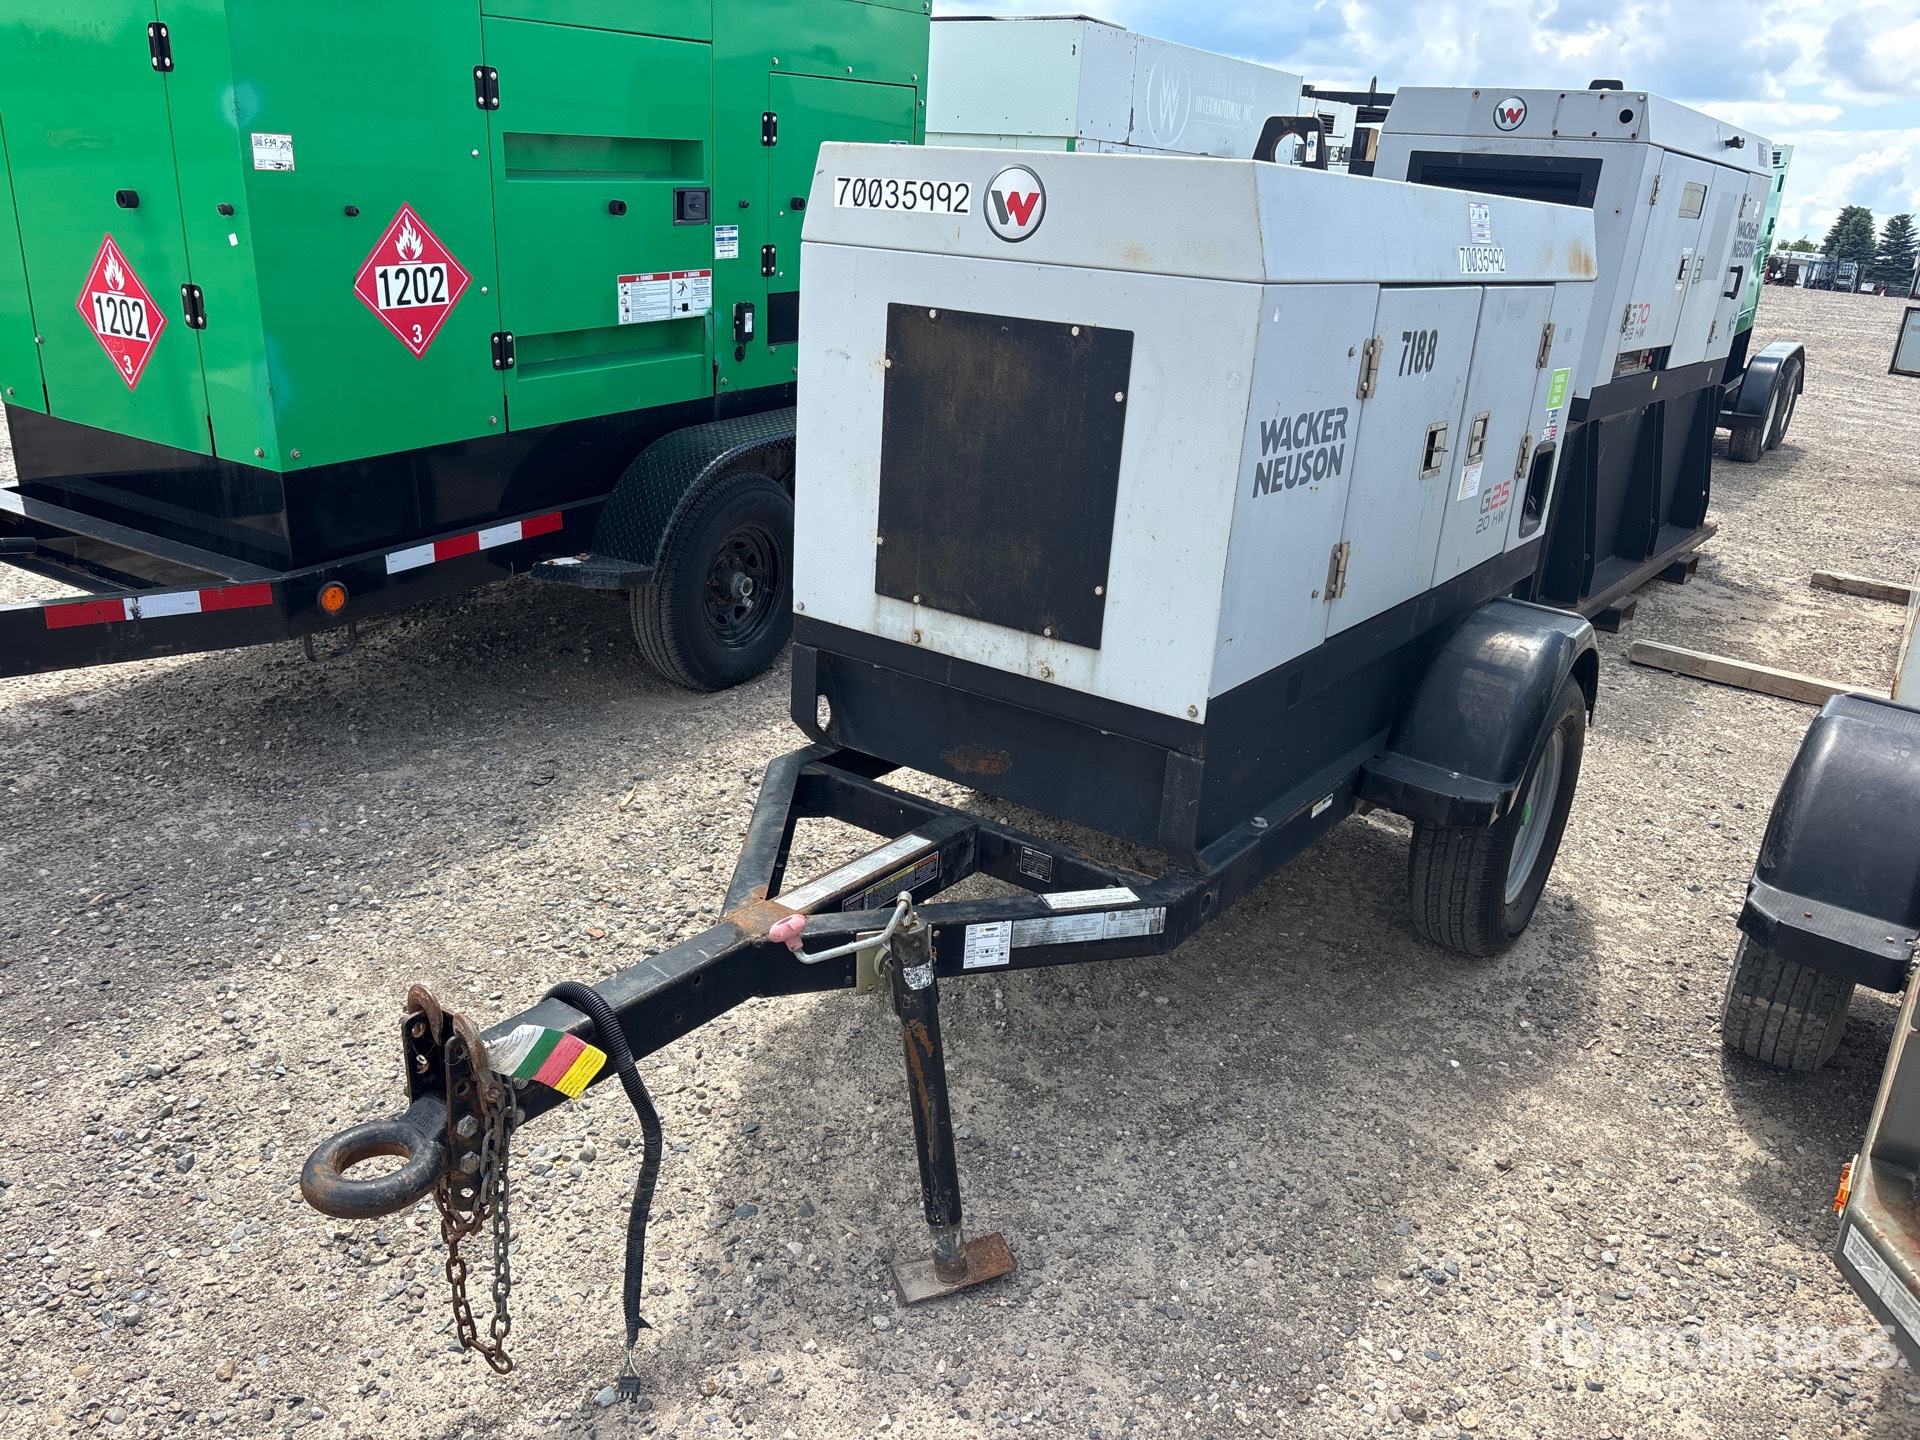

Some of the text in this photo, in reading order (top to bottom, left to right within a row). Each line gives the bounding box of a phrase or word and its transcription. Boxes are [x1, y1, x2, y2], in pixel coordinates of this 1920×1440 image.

[837, 178, 970, 213] 70035992
[1737, 220, 1759, 240] WACKER
[1459, 247, 1505, 272] 70035992
[1731, 241, 1756, 259] NEUSON
[379, 266, 445, 307] 1202
[95, 295, 147, 339] 1202
[412, 324, 423, 343] 3
[123, 355, 133, 374] 3
[1399, 329, 1438, 377] 7188
[1260, 407, 1348, 457] WACKER
[1252, 444, 1345, 498] NEUSON
[1480, 480, 1511, 514] G25
[1475, 515, 1490, 535] 20
